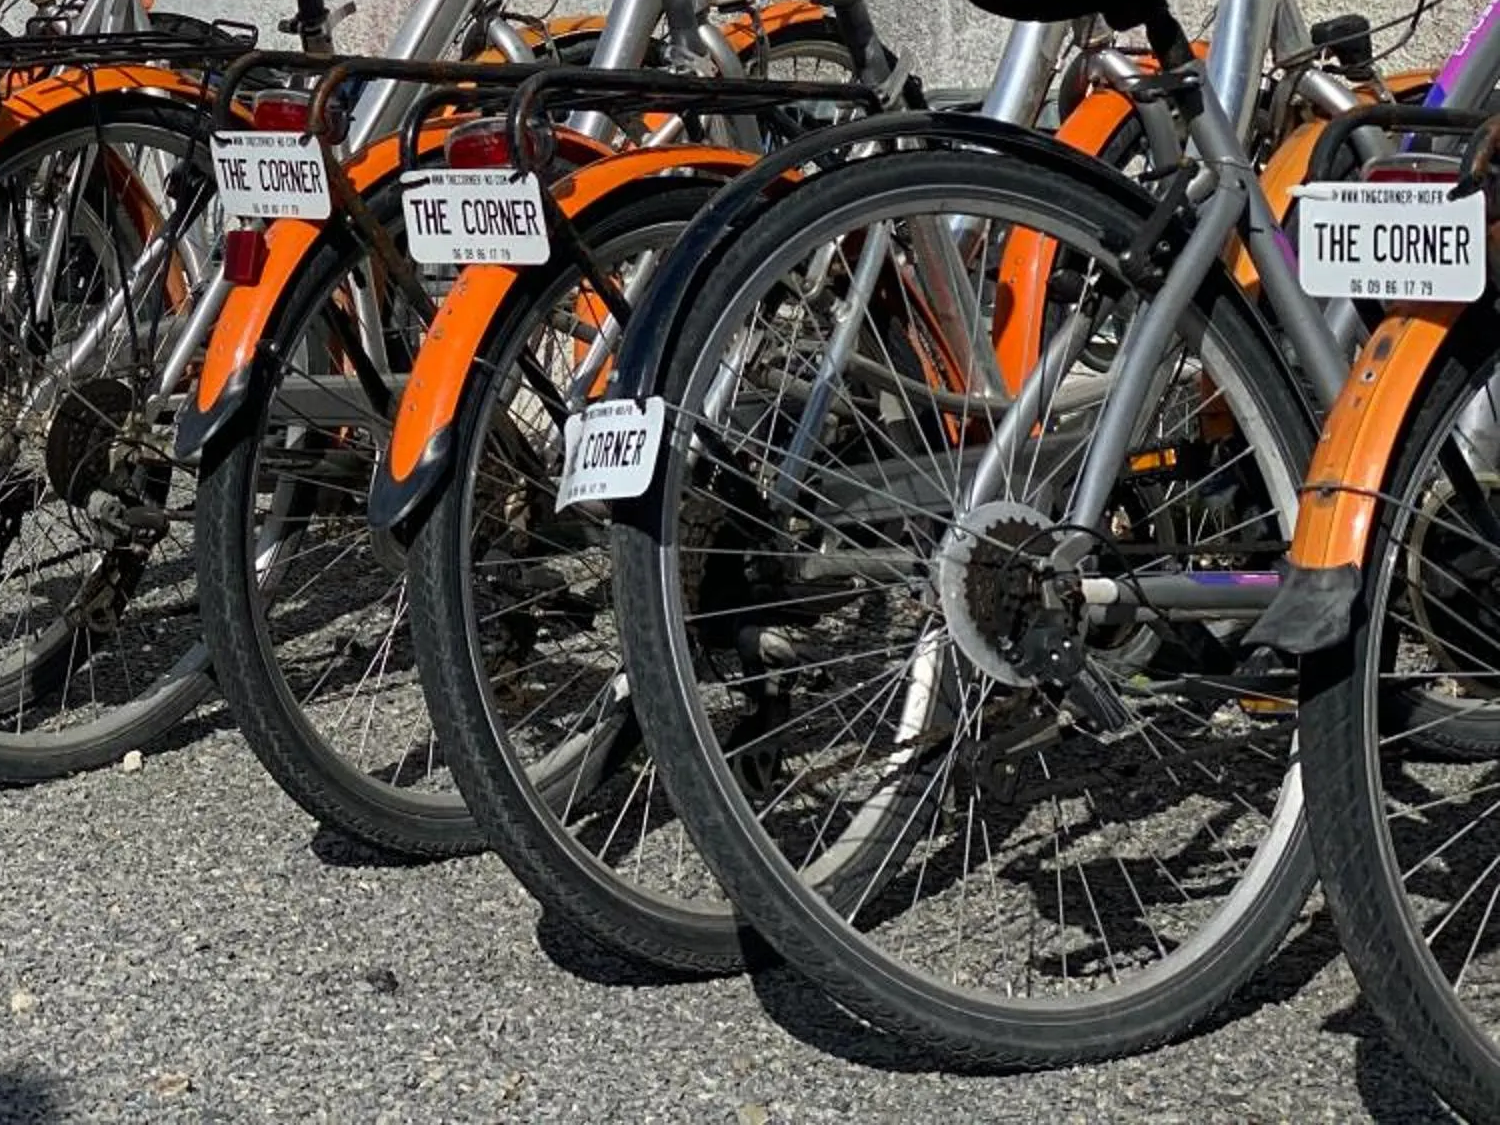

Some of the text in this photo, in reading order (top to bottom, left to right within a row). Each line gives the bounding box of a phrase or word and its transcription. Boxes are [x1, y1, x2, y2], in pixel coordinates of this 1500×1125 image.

[218, 158, 323, 194] THE CORNER
[410, 198, 540, 236] THE CORNER
[1314, 223, 1470, 265] THE CORNER
[1350, 278, 1363, 294] 06
[1368, 279, 1381, 295] 09
[1404, 280, 1415, 296] 17
[1421, 280, 1433, 296] 79
[583, 429, 647, 469] CORNER
